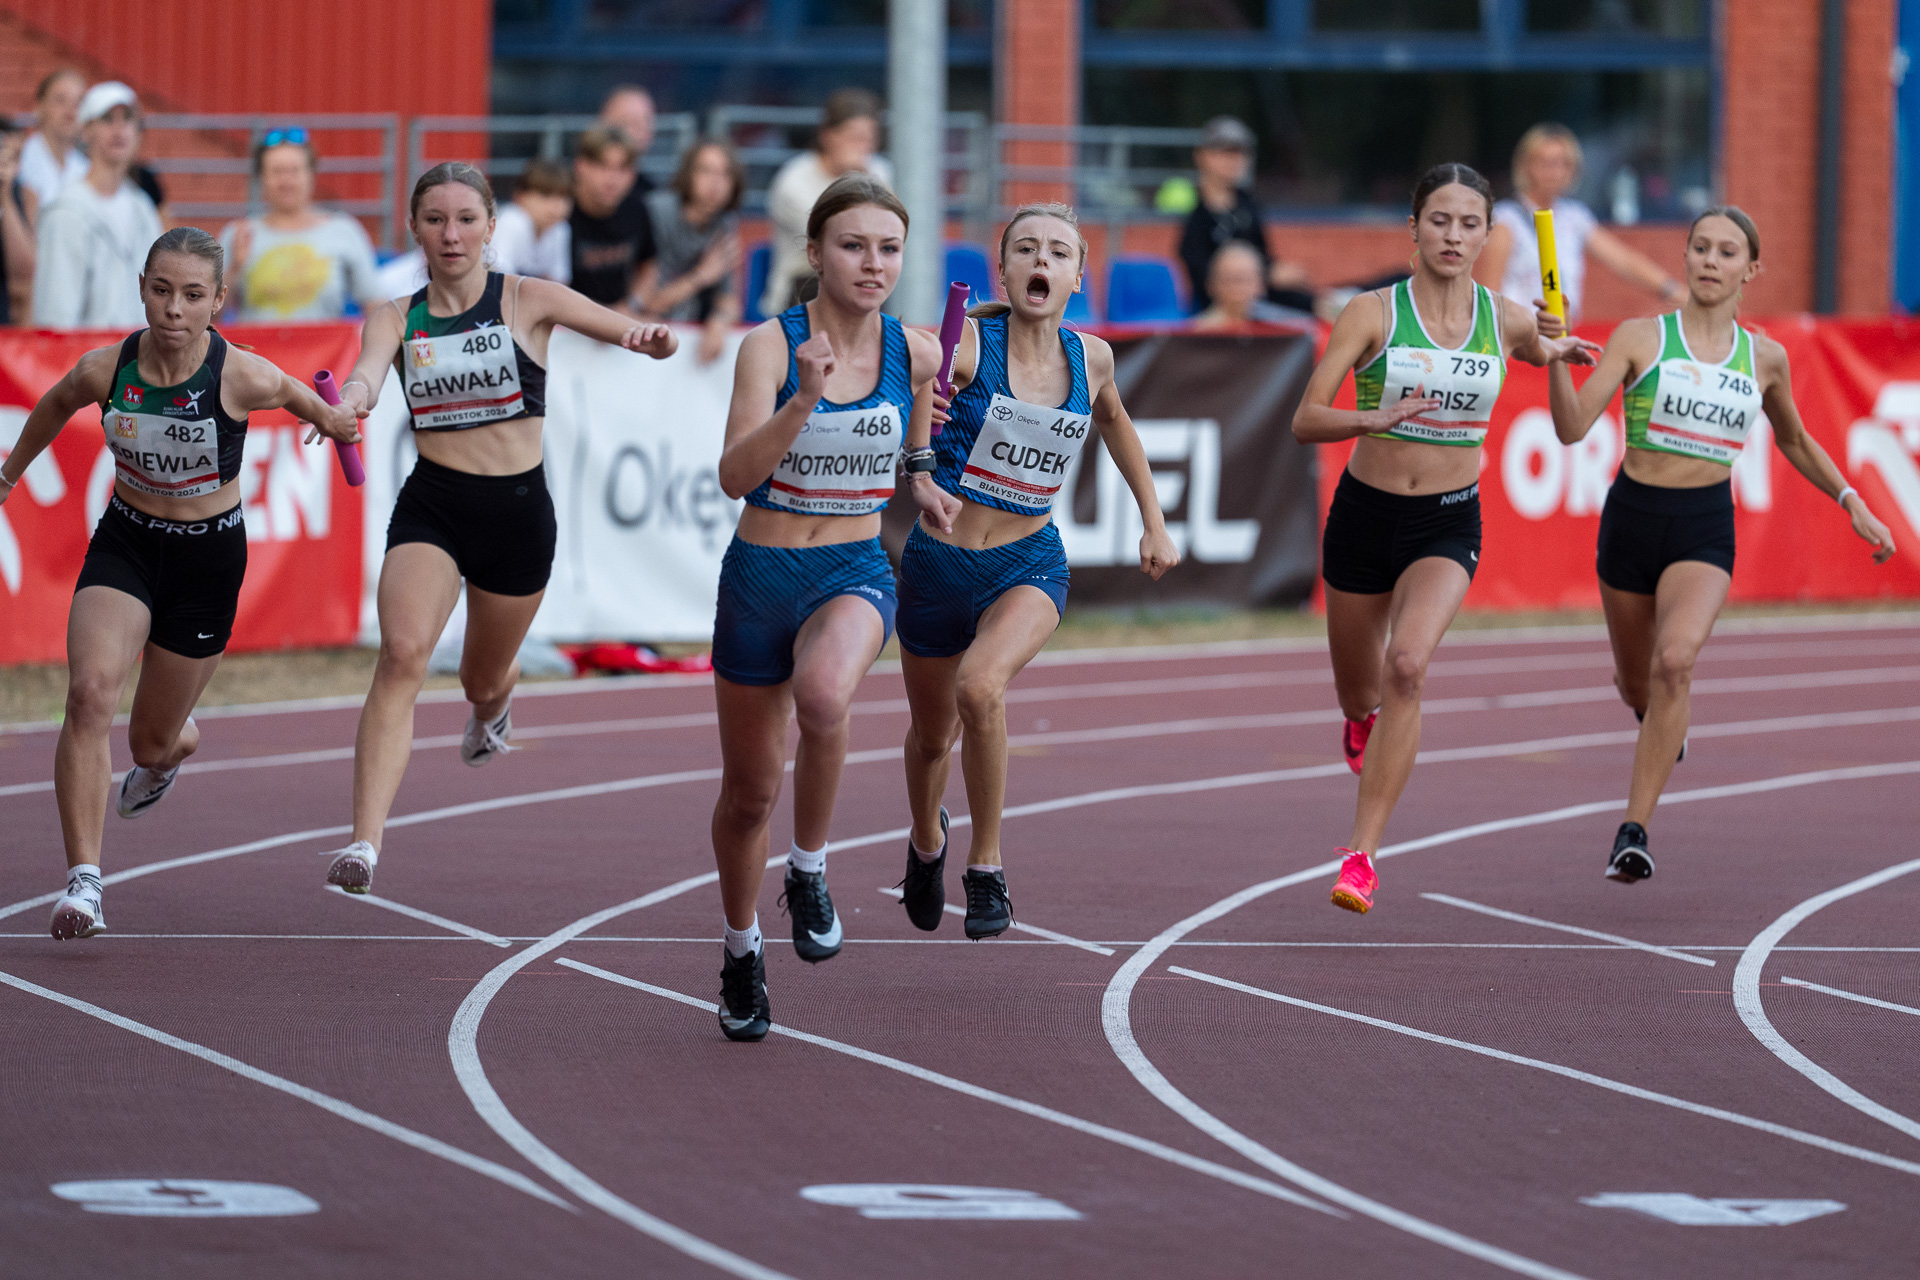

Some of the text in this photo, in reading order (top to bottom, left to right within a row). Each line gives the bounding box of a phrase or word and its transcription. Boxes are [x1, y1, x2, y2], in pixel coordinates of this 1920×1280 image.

[1542, 269, 1556, 291] 4
[462, 333, 502, 355] 480
[1451, 357, 1489, 377] 739
[409, 365, 514, 399] CHWAŁA
[1718, 372, 1753, 396] 748
[1400, 386, 1480, 411] FBISZ
[432, 408, 507, 423] BIAŁYSTOK 2024
[1017, 415, 1040, 426] Okęcie
[1663, 394, 1746, 430] ŁUCZKA
[164, 424, 206, 443] 482
[852, 415, 891, 437] 468
[1050, 418, 1087, 439] 466
[1446, 430, 1467, 438] 2024
[111, 441, 212, 474] ŚPIEWLA
[779, 451, 894, 477] PIOTROWICZ
[991, 441, 1071, 475] CUDEK
[128, 477, 175, 497] BIAŁYSTOK
[177, 487, 201, 497] 2024
[602, 436, 740, 554] Okę
[979, 481, 1034, 504] BIAŁYSTOK
[1034, 497, 1050, 505] 2024
[1440, 489, 1470, 506] NIKE
[789, 497, 872, 511] BIAŁYSTOK 2024
[112, 496, 243, 535] NIKE PRO NIK
